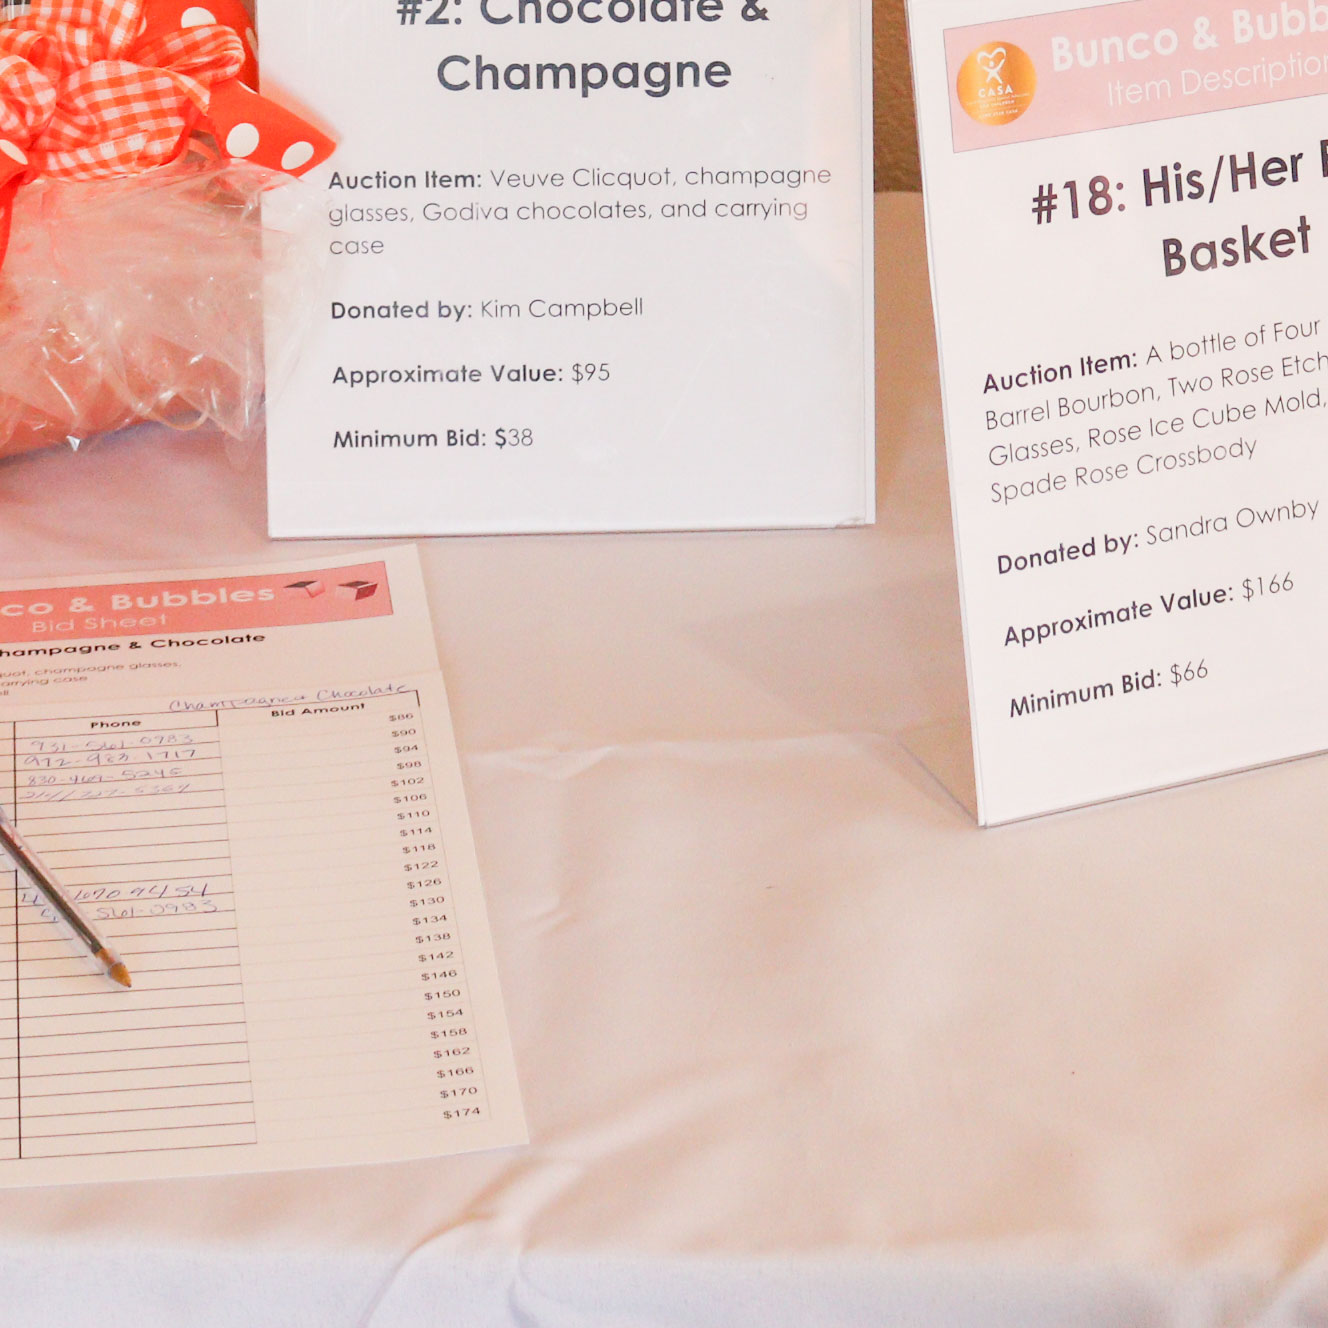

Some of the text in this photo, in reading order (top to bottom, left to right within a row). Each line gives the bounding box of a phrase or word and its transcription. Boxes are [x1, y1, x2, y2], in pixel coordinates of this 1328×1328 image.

[1052, 28, 1178, 72] Bunco
[1194, 17, 1219, 50] &
[437, 55, 731, 98] Champagne
[978, 84, 1013, 97] CASA
[1108, 77, 1171, 107] Item
[329, 166, 831, 192] Auction Item: Veuve Clicquot, champagne
[1032, 175, 1125, 225] #18:
[1144, 151, 1304, 206] His/Her
[329, 199, 808, 225] glasses, Godiva chocolates, and carrying
[329, 237, 384, 256] case
[1163, 216, 1311, 277] Basket
[330, 298, 643, 323] Donated by: Kim Campbell
[983, 363, 1072, 394] Auction
[1080, 351, 1137, 377] Item:
[1145, 345, 1162, 366] A
[1169, 332, 1236, 361] bottle
[1244, 325, 1266, 347] of
[1274, 319, 1320, 343] Four
[332, 362, 610, 389] Approximate Value: $95
[986, 404, 1050, 430] Barrel
[1058, 385, 1160, 418] Bourbon,
[1169, 374, 1213, 397] Two
[1221, 362, 1274, 388] Rose
[333, 427, 534, 450] Minimum Bid: $38
[989, 435, 1081, 466] Glasses,
[1089, 423, 1141, 449] Rose
[1149, 414, 1184, 438] Ice
[1192, 401, 1256, 430] Cube
[1264, 388, 1326, 417] Mold,
[991, 436, 1257, 506] Spade Rose Crossbody
[997, 497, 1319, 574] Donated by: Sandra Ownby
[77, 596, 95, 613] &
[111, 586, 275, 611] Bubbles
[1004, 571, 1294, 647] Approximate Value: $166
[32, 613, 166, 634] Bid Sheet
[129, 641, 142, 649] &
[151, 633, 266, 649] Chocolate
[1010, 659, 1208, 719] Minimum Bid: $66
[91, 721, 141, 729] Phone
[271, 708, 294, 717] Bid
[302, 703, 365, 715] Amount
[391, 777, 424, 787] $102
[404, 861, 439, 871] $122
[418, 951, 454, 962] $142
[433, 1047, 471, 1058] $162
[440, 1086, 477, 1098] $170
[443, 1107, 481, 1119] $174
